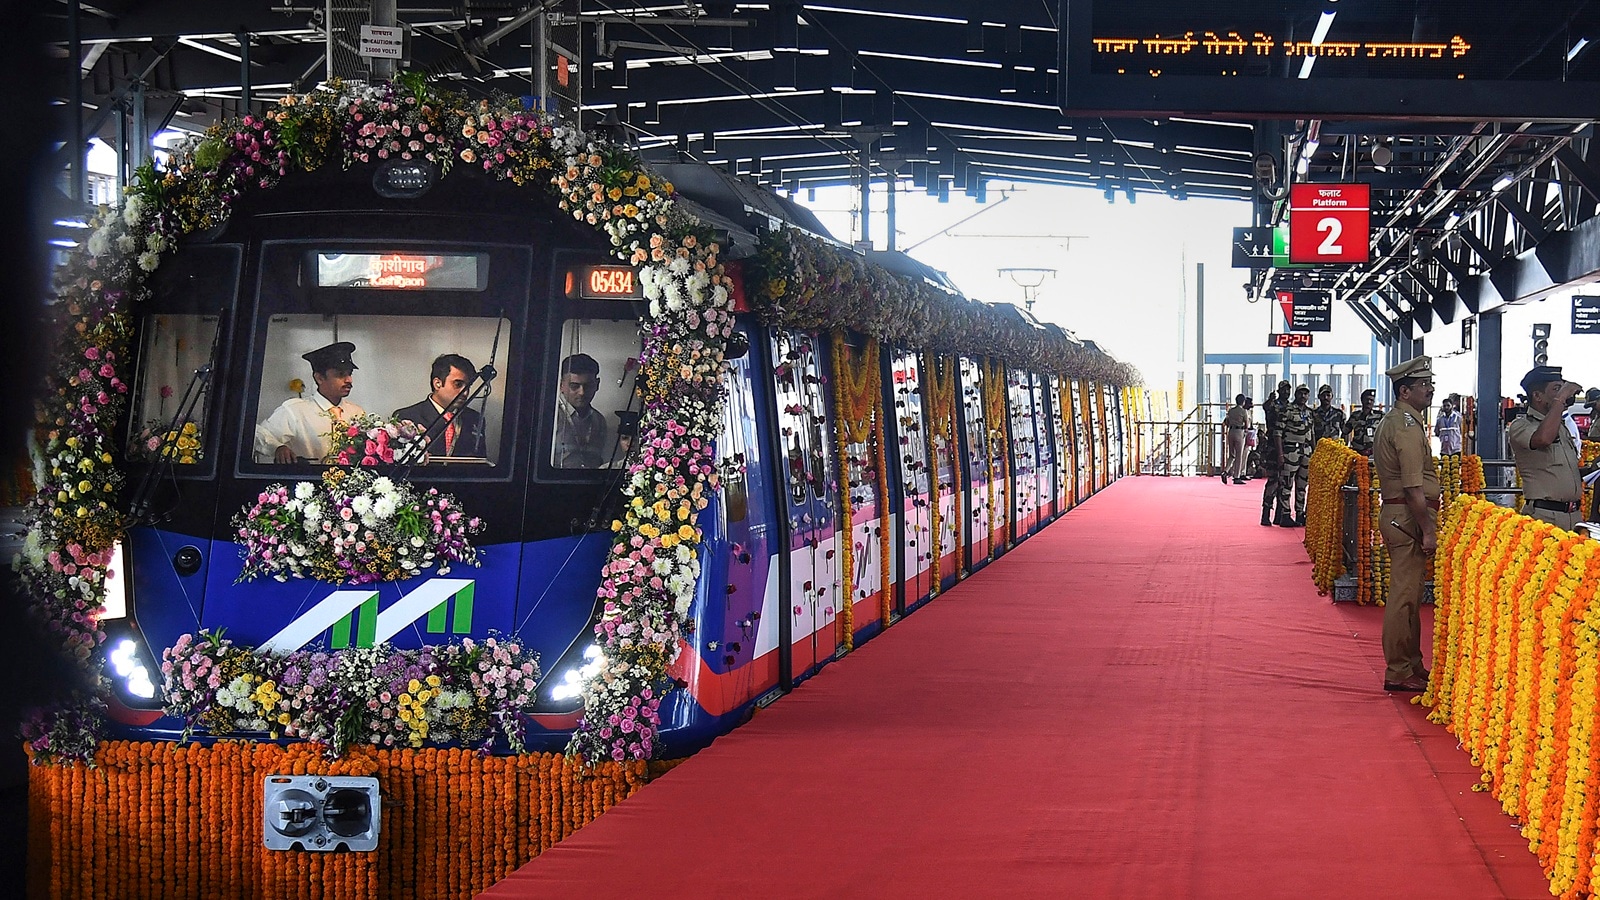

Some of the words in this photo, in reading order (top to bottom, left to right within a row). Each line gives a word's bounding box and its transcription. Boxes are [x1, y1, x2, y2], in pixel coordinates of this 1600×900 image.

[1317, 189, 1342, 198] फलाट
[1317, 217, 1343, 255] 2
[370, 275, 425, 287] Kashigaon
[591, 270, 633, 293] 05434
[1276, 335, 1310, 347] 12:24
